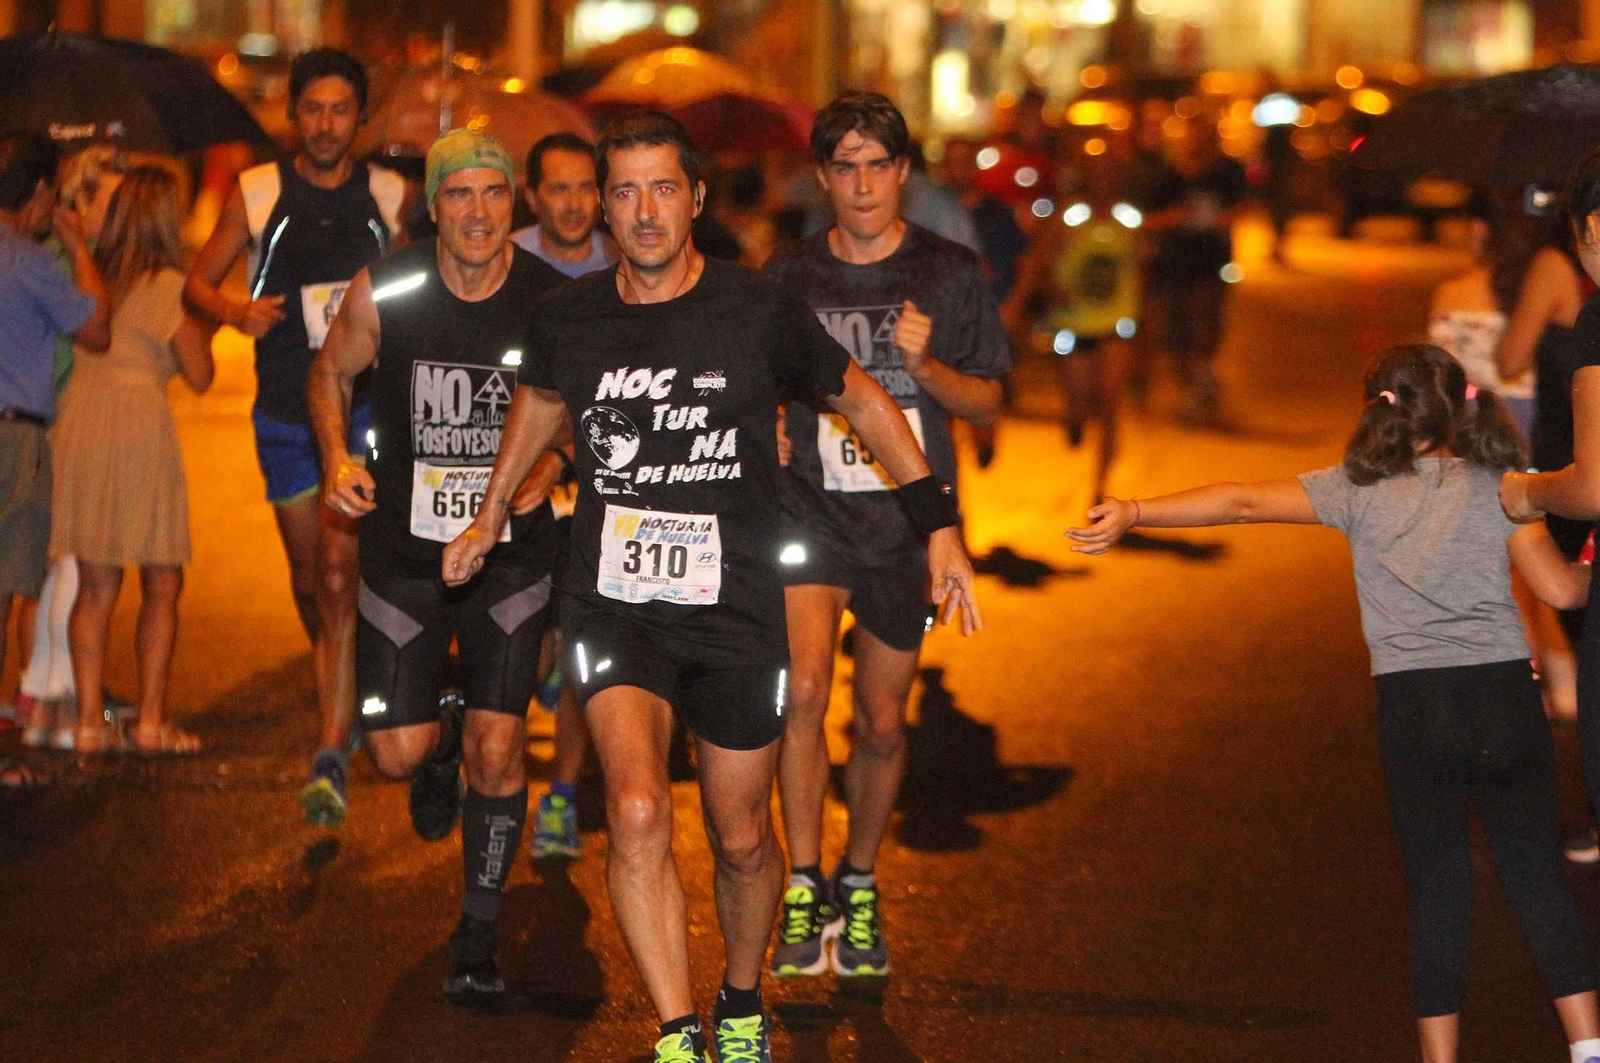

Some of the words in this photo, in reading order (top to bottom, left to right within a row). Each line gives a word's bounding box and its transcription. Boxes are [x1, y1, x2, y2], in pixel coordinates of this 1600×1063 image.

[414, 365, 472, 426] NO
[595, 367, 678, 401] NOC
[652, 404, 708, 432] TUR
[414, 425, 504, 456] FOSFOYESO
[689, 428, 738, 462] NA
[445, 470, 491, 480] NOCTUR
[460, 480, 488, 490] HUEL
[636, 466, 665, 484] DE
[667, 462, 741, 485] HUELVA
[634, 529, 654, 541] DE
[657, 530, 709, 545] HUELVA
[623, 540, 688, 579] 310
[636, 575, 670, 585] FRANCISCO
